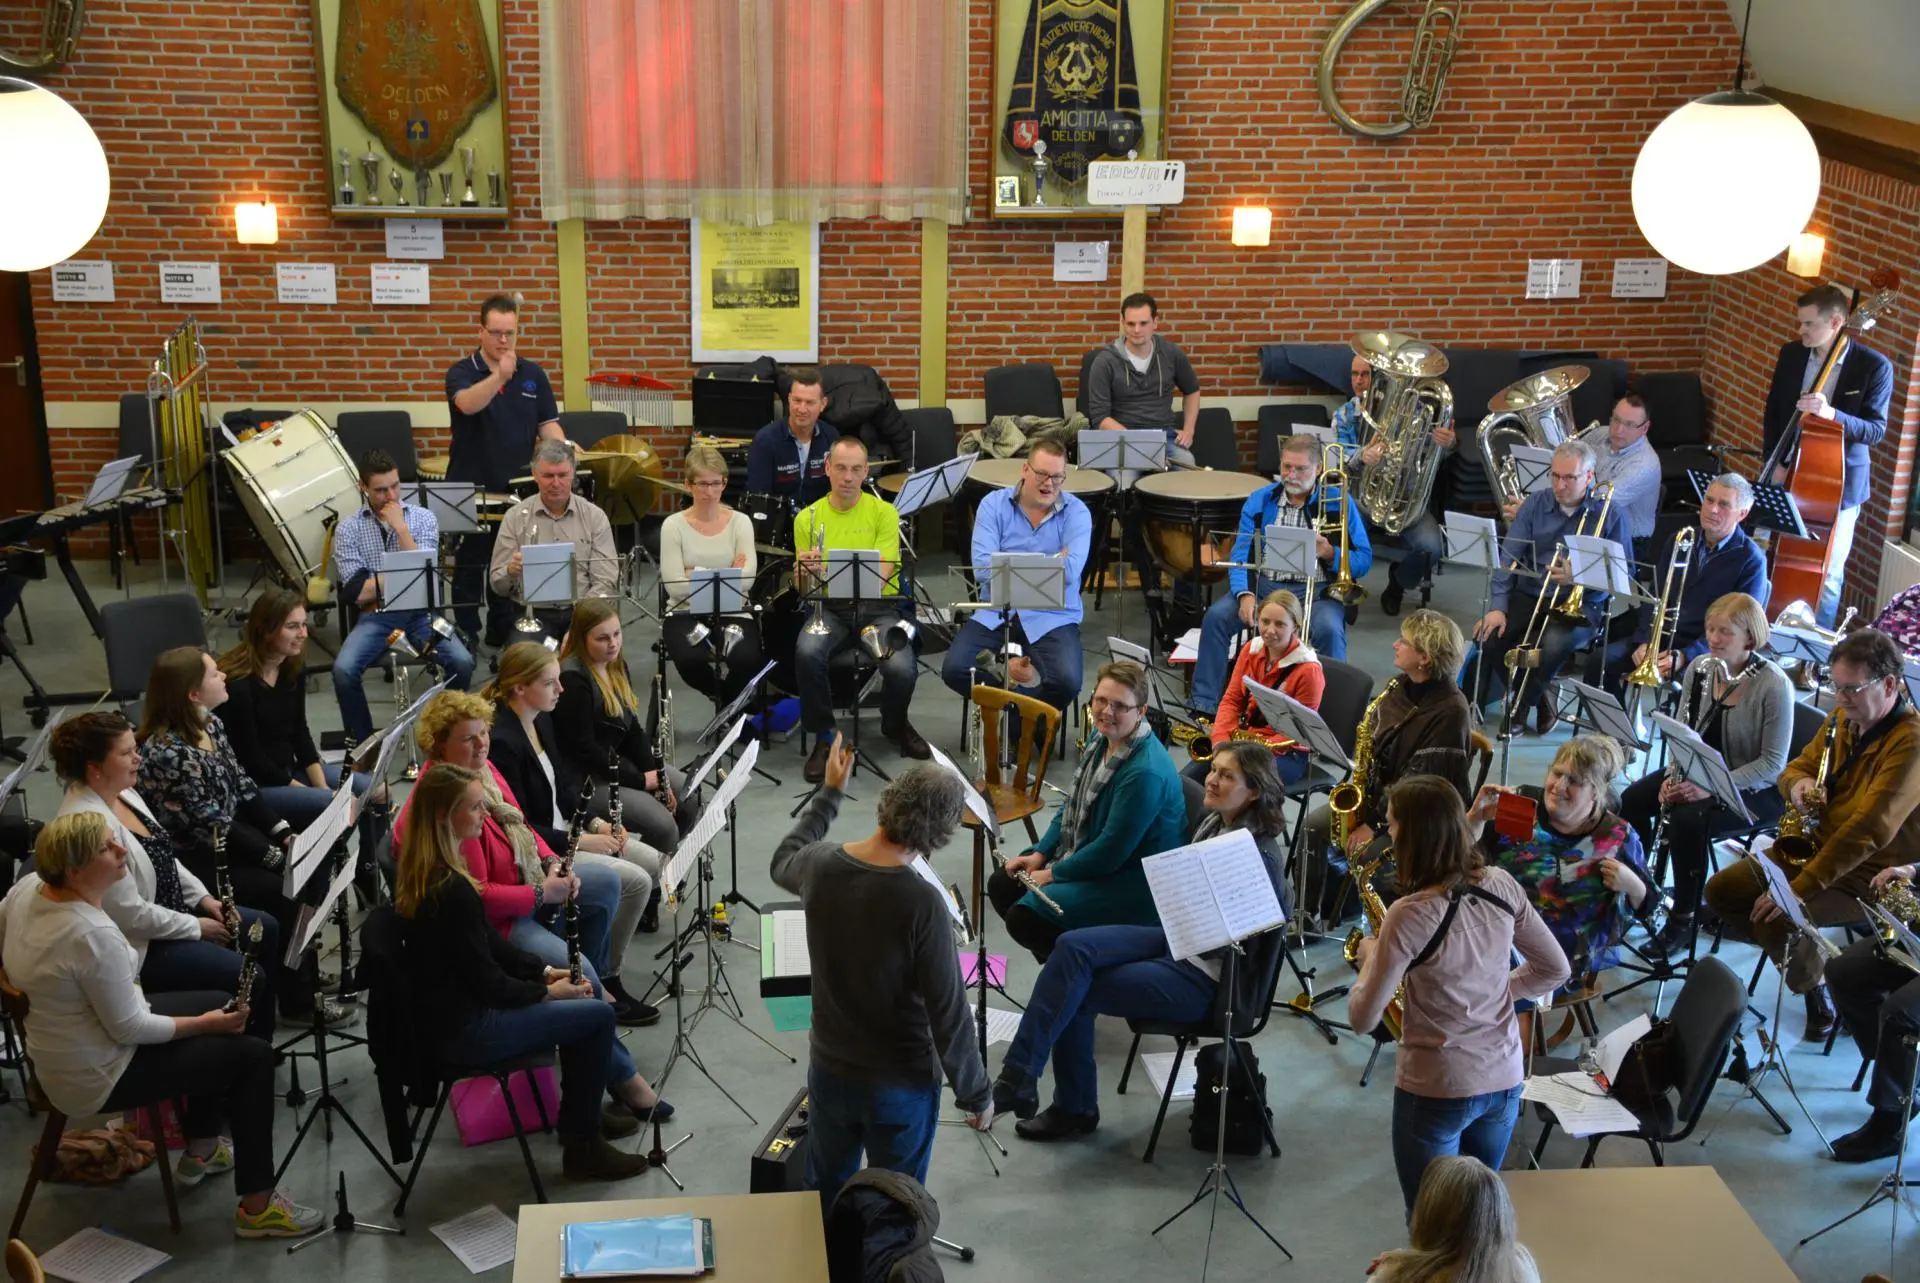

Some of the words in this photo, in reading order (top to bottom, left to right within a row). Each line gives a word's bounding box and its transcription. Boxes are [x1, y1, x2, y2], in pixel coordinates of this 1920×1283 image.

[381, 84, 450, 105] DELDEN
[1040, 109, 1109, 128] AMICITIA
[1051, 130, 1096, 142] DELDEN
[410, 225, 417, 233] 5
[1078, 249, 1085, 257] 5
